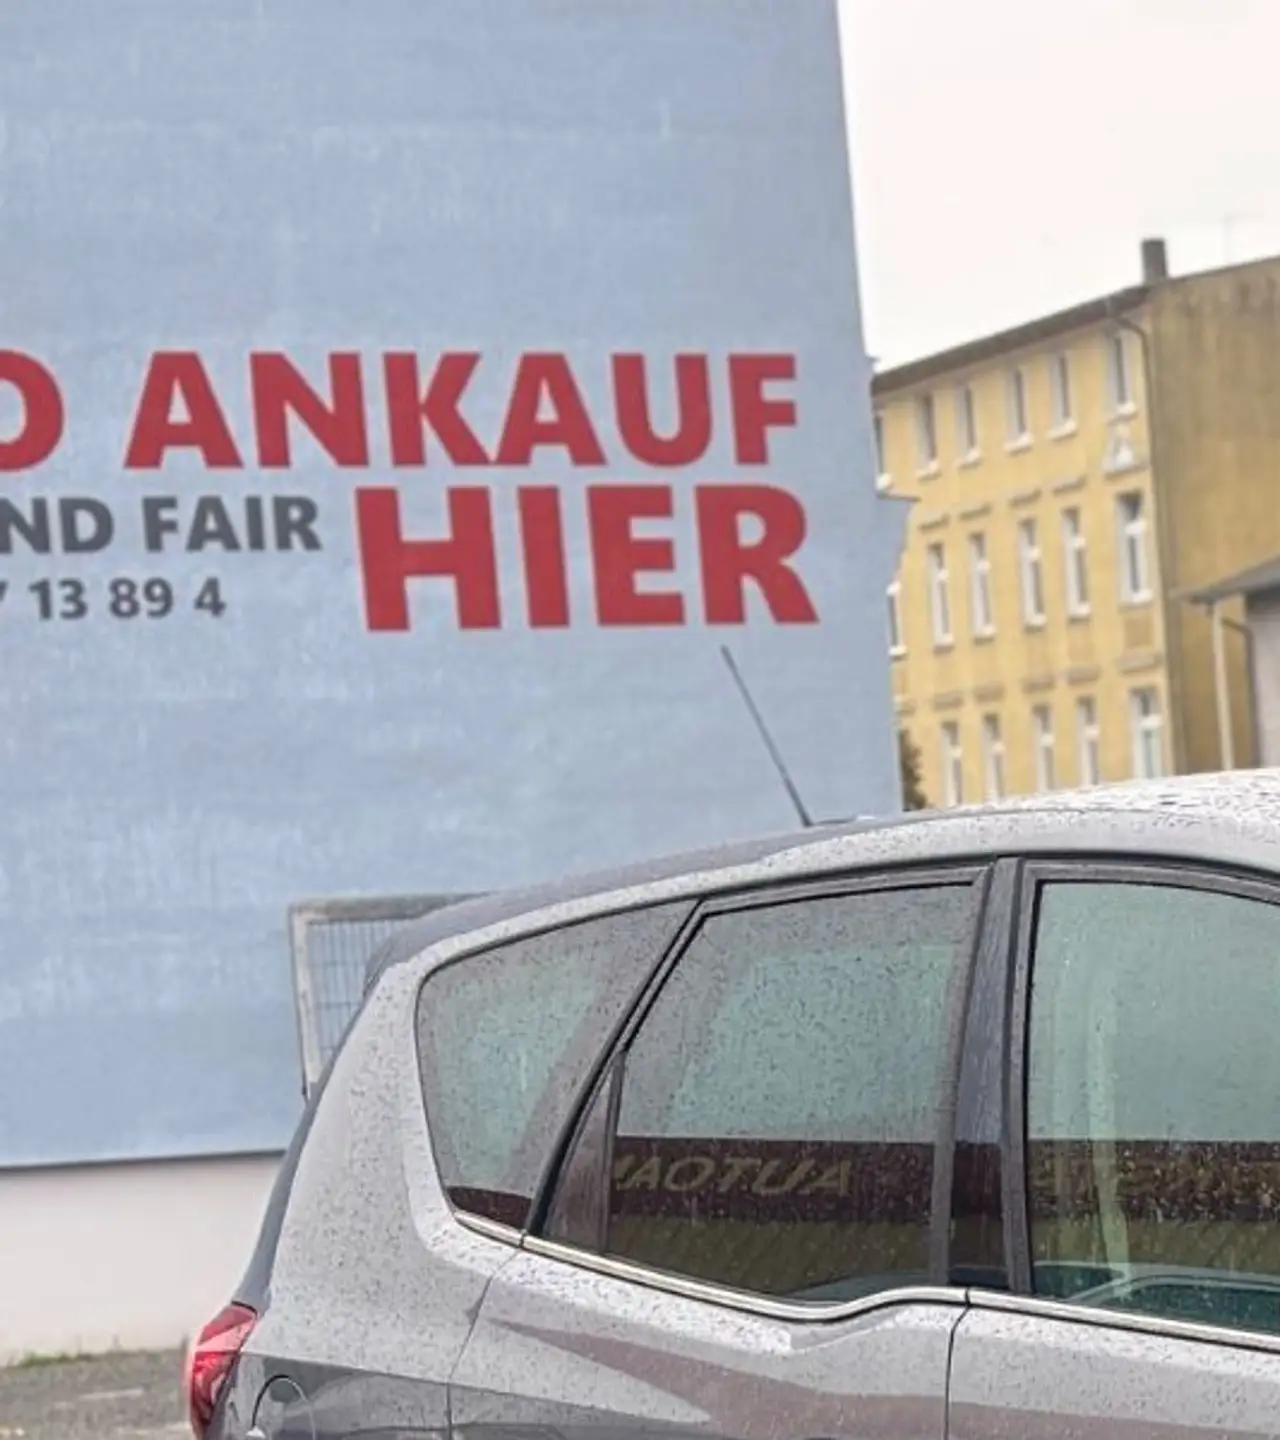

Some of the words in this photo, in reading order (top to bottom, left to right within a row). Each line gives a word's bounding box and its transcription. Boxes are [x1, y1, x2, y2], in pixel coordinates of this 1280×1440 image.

[123, 351, 797, 470] ANKAUF
[142, 495, 322, 552] FAIR
[355, 485, 819, 631] HIER
[28, 577, 88, 620] 13
[109, 577, 174, 619] 89
[194, 577, 227, 618] 4
